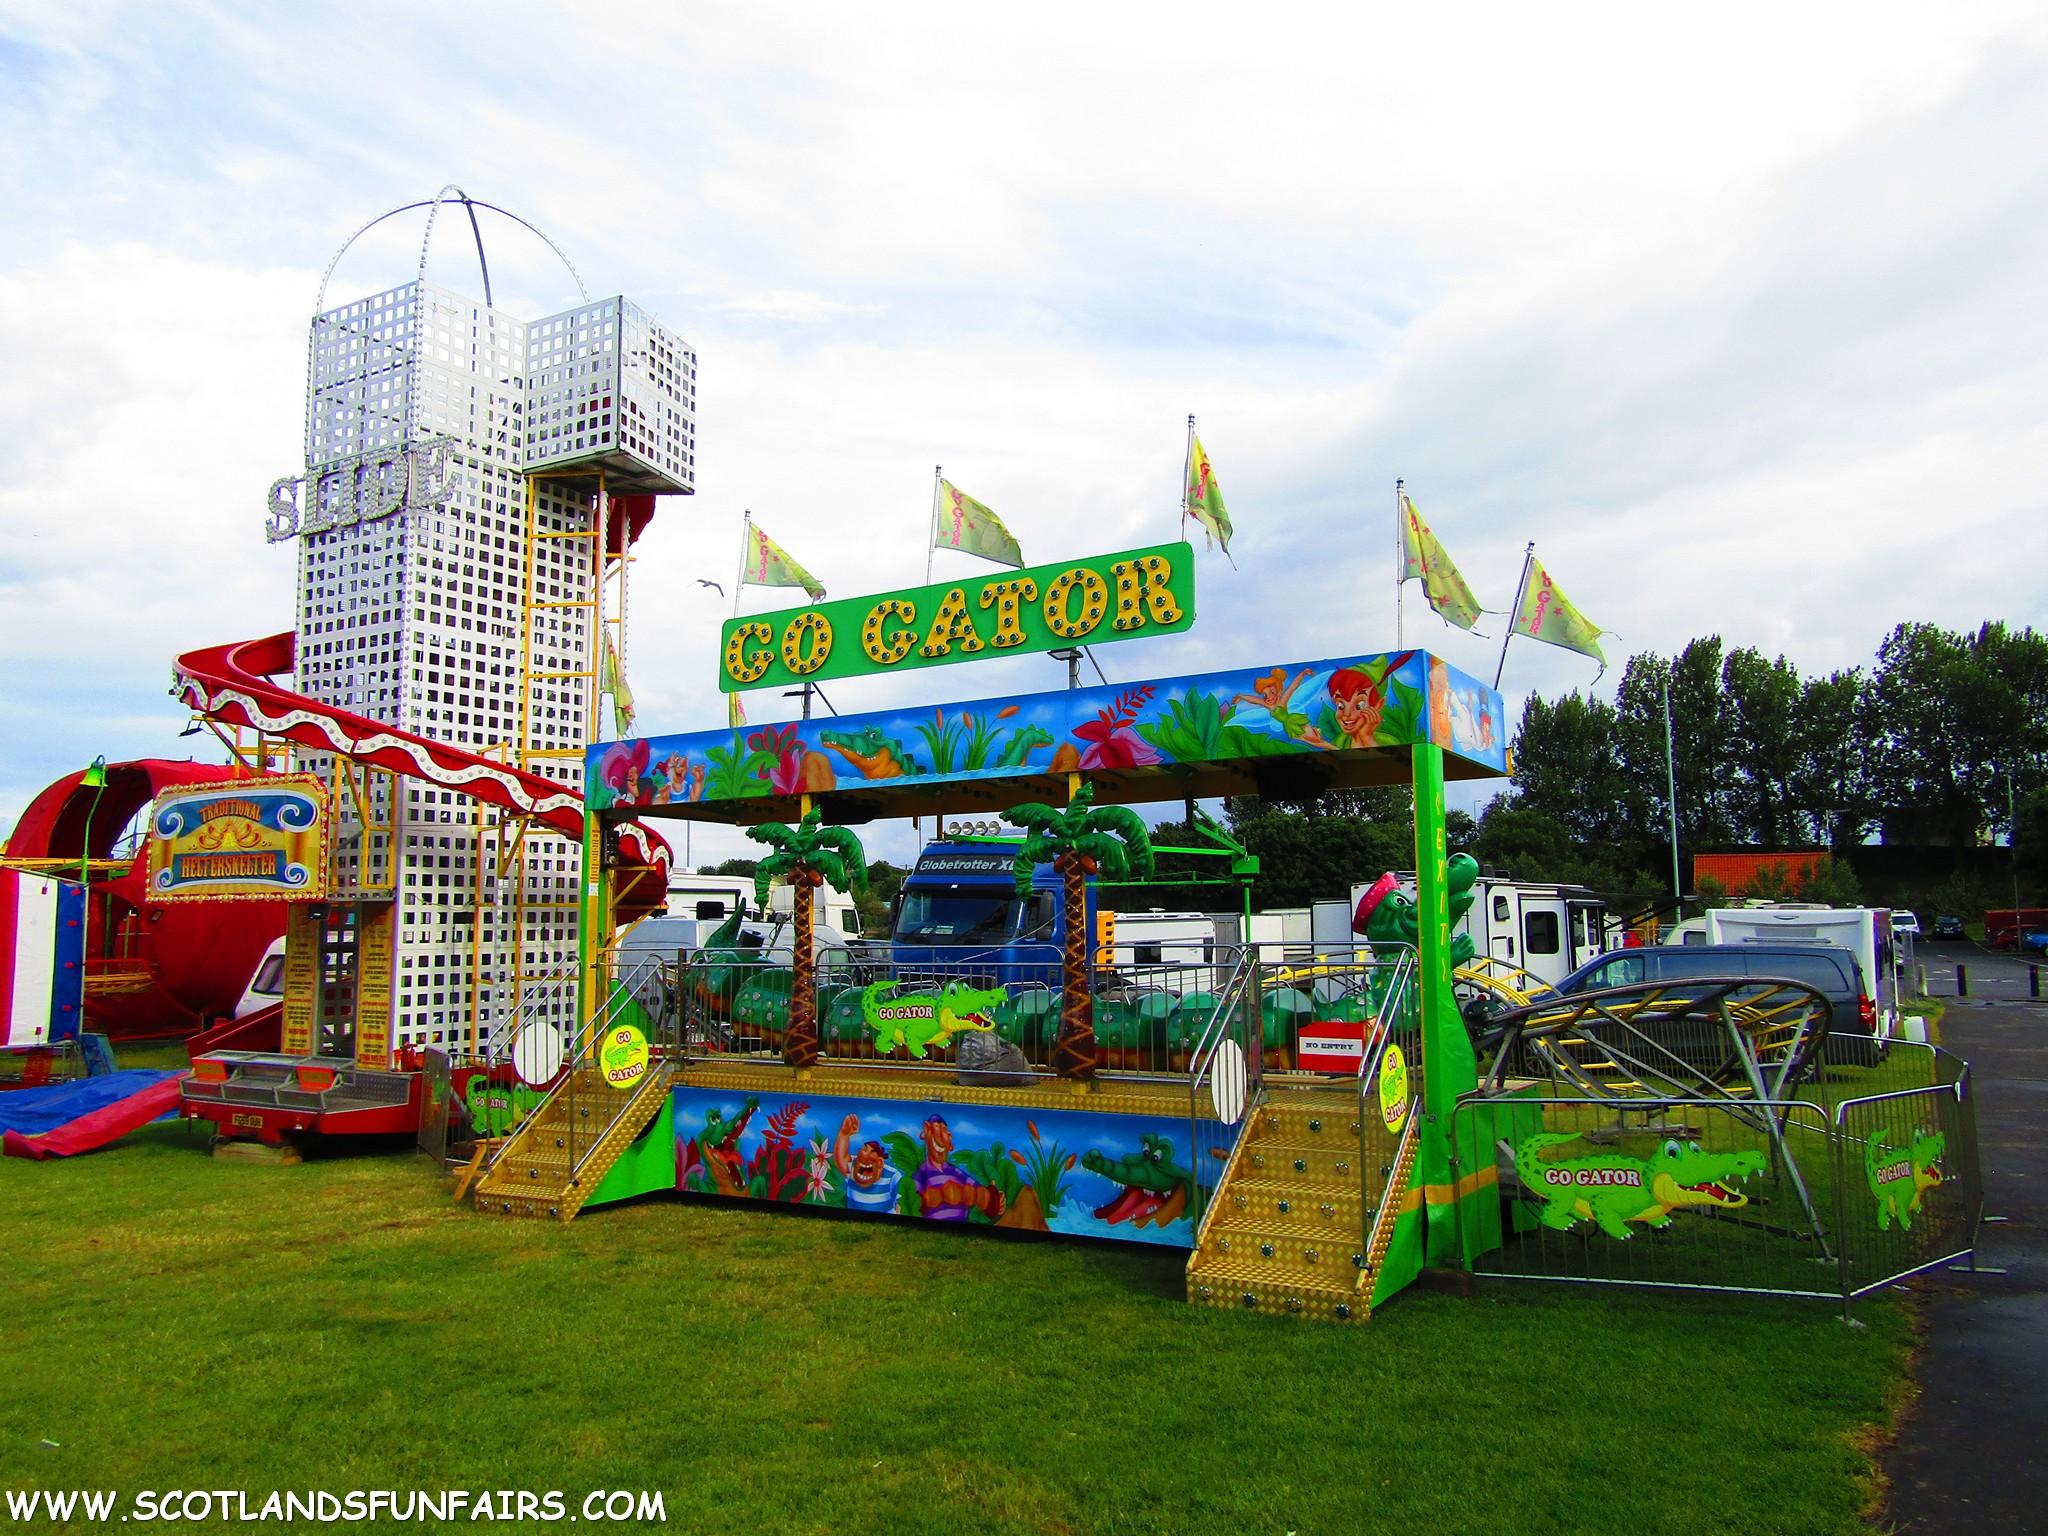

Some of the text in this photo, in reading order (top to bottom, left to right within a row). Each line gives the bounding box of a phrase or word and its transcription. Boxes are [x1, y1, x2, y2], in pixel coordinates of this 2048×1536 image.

[266, 434, 458, 544] SLIDE
[951, 507, 964, 547] GATOR
[757, 545, 769, 583] GATOR
[725, 555, 1183, 683] GO GATOR
[1528, 590, 1551, 635] GATOR
[200, 798, 261, 824] TRADITIONAL
[181, 853, 276, 878] HELTERSKELTER
[919, 859, 997, 872] Globetrotter
[1436, 828, 1448, 947] EXIT
[879, 1005, 935, 1020] GO GATOR
[617, 1031, 631, 1044] GO
[1321, 1043, 1354, 1051] ENTRY
[609, 1062, 645, 1082] GATOR
[1387, 1052, 1397, 1071] GO
[487, 1097, 508, 1110] ATOR
[1385, 1097, 1408, 1123] GATOR
[1545, 1167, 1642, 1187] GO GATOR
[1877, 1160, 1911, 1185] GO GATOR
